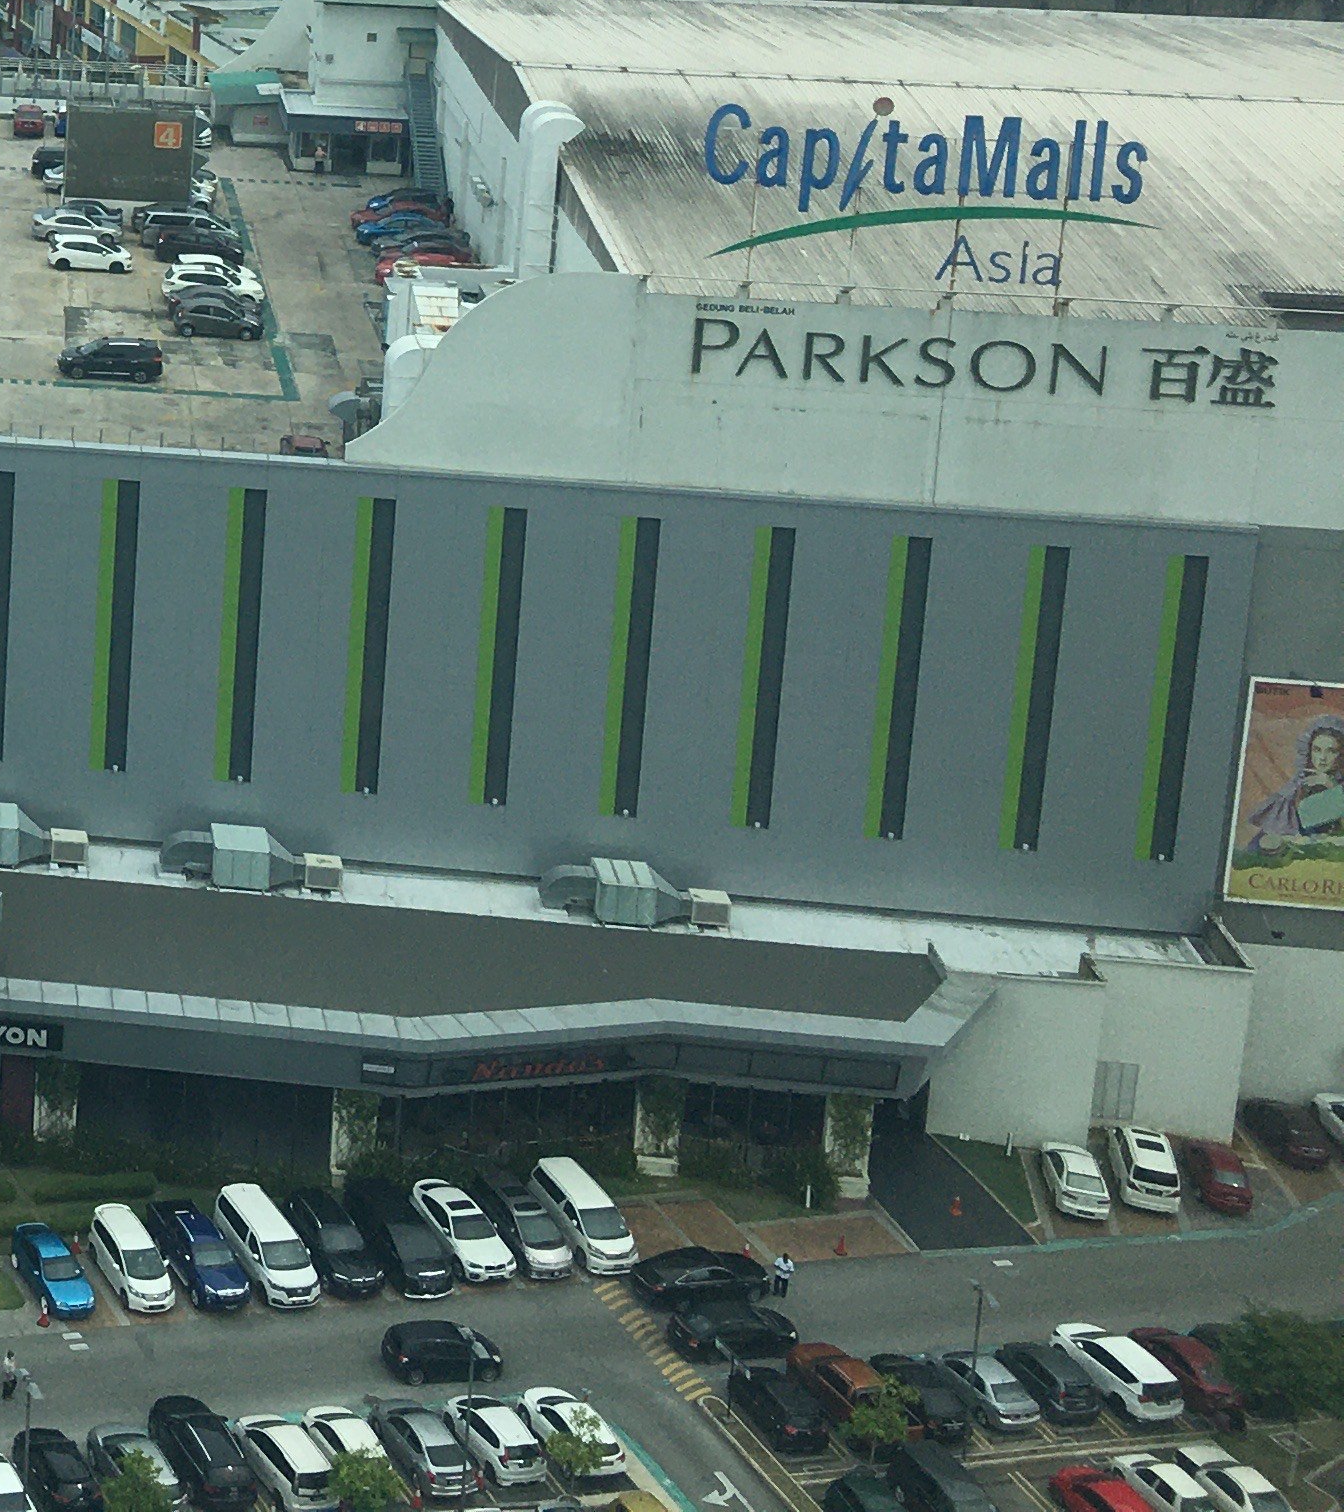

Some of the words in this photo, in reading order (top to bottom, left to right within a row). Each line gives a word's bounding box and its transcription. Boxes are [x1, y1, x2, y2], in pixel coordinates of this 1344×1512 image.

[159, 127, 177, 146] 4
[705, 97, 1148, 213] CapitaMalls
[935, 234, 1062, 287] Asia
[695, 302, 735, 313] GEDUNG
[738, 304, 796, 316] BELI-BELAH
[691, 317, 1108, 397] PARKSON
[1141, 344, 1278, 408] 百盛
